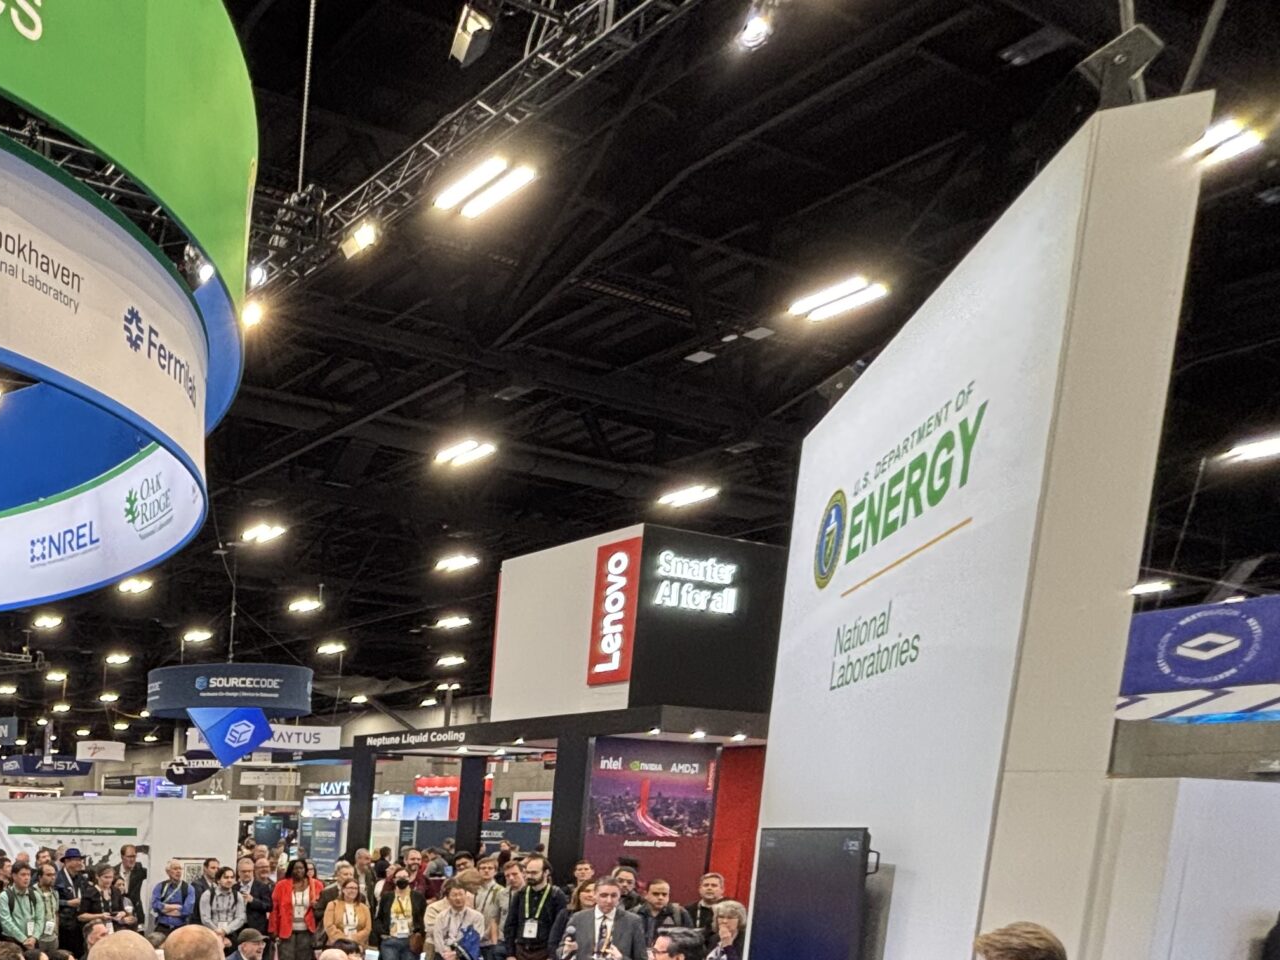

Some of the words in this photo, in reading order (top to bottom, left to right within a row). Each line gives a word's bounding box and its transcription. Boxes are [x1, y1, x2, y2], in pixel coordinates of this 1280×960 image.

[21, 264, 80, 315] Laboratory
[148, 324, 197, 409] Fermilab
[853, 471, 871, 497] U.S.
[873, 400, 953, 477] DEPARTMENT
[955, 380, 976, 413] OF
[140, 472, 162, 501] OAK
[845, 399, 989, 565] ENERGY
[140, 488, 171, 525] RIDGE
[48, 521, 100, 559] NREL
[658, 550, 737, 585] Smarter
[593, 551, 629, 673] Lenovo
[654, 580, 681, 606] AI
[681, 583, 710, 612] for
[709, 588, 737, 614] all
[833, 600, 893, 658] National
[209, 677, 280, 688] SOURCECODE
[829, 634, 921, 691] Laboratories
[366, 736, 400, 747] Neptune
[401, 732, 429, 745] Liquid
[430, 730, 466, 743] Cooling
